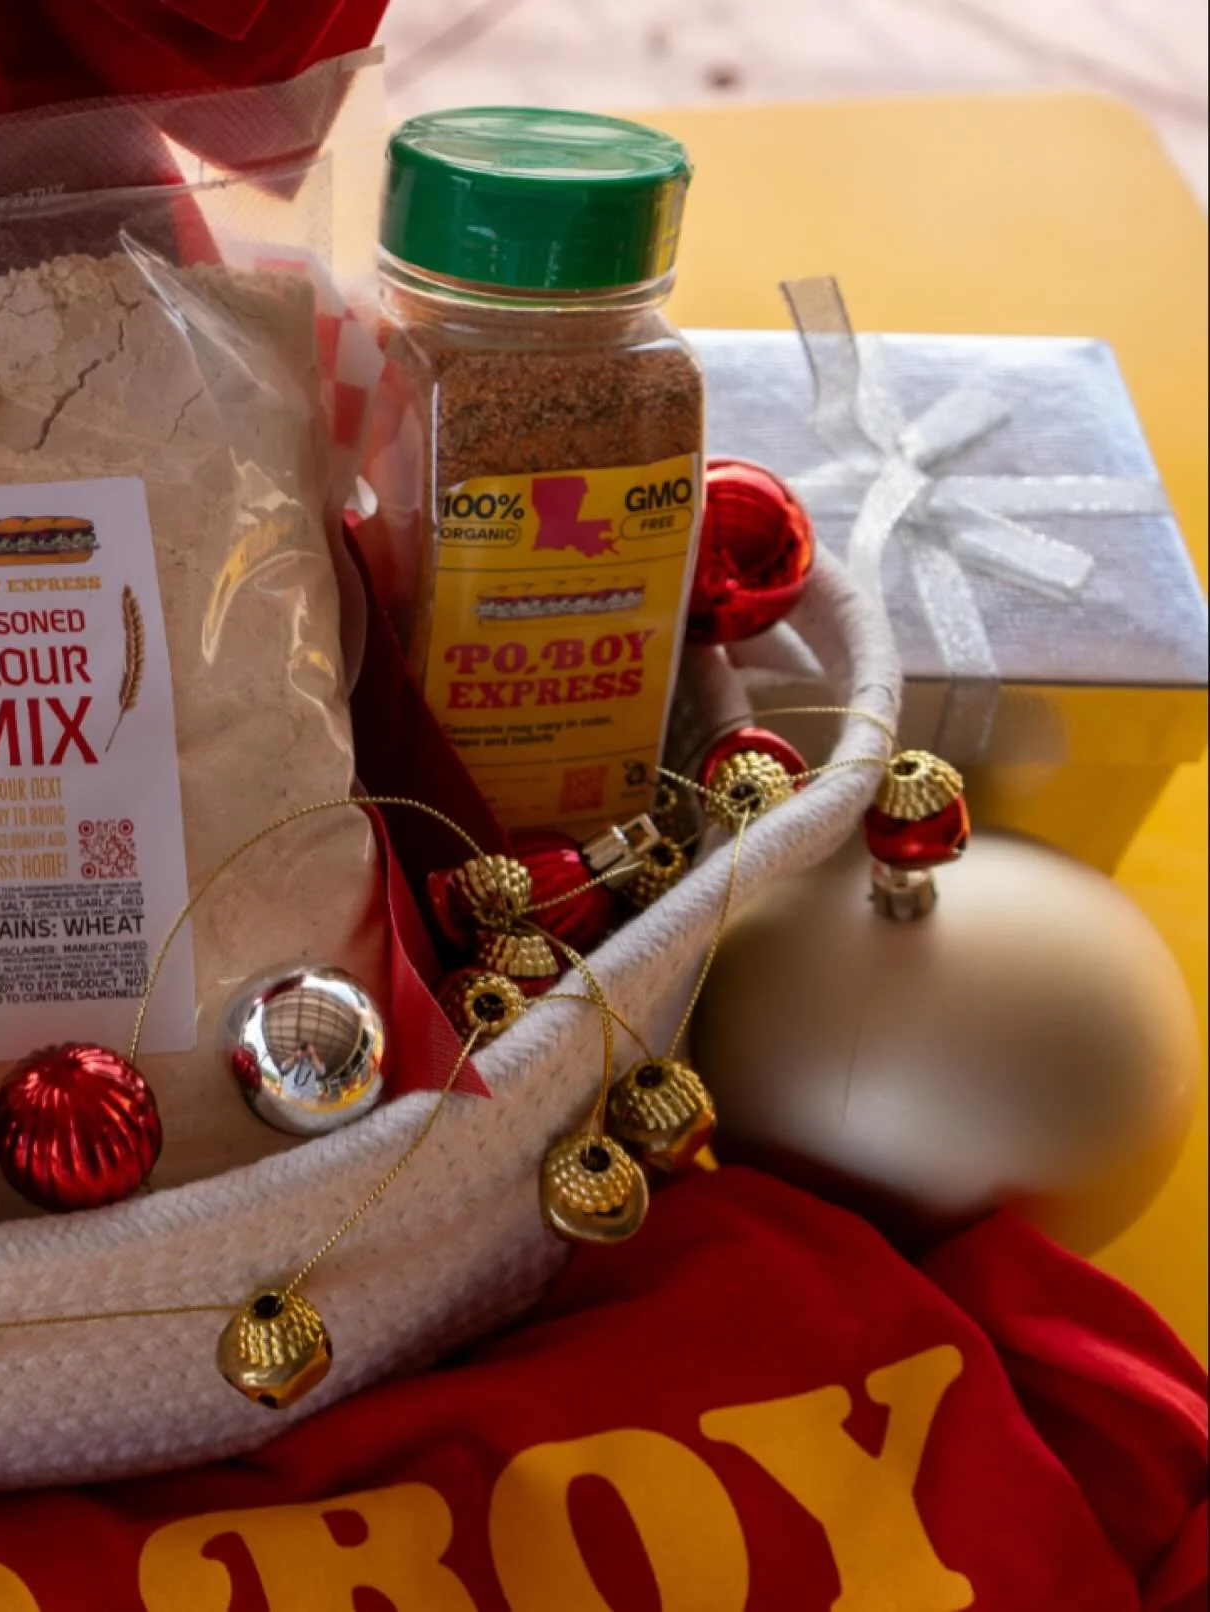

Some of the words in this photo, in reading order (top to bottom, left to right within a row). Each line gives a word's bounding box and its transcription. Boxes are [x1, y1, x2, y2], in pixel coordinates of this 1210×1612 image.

[624, 477, 693, 513] GMO
[440, 493, 525, 521] 100%
[440, 526, 517, 542] ORGANIC
[640, 514, 675, 532] FREE
[5, 575, 102, 594] EXPRESS
[447, 667, 645, 710] EXPRESS
[31, 776, 62, 800] NEXT
[14, 806, 26, 826] TO
[29, 804, 66, 825] BRING
[21, 852, 69, 880] HOME!
[63, 913, 145, 938] WHEAT
[62, 940, 148, 953] MANUFACTURED
[18, 981, 34, 991] TO
